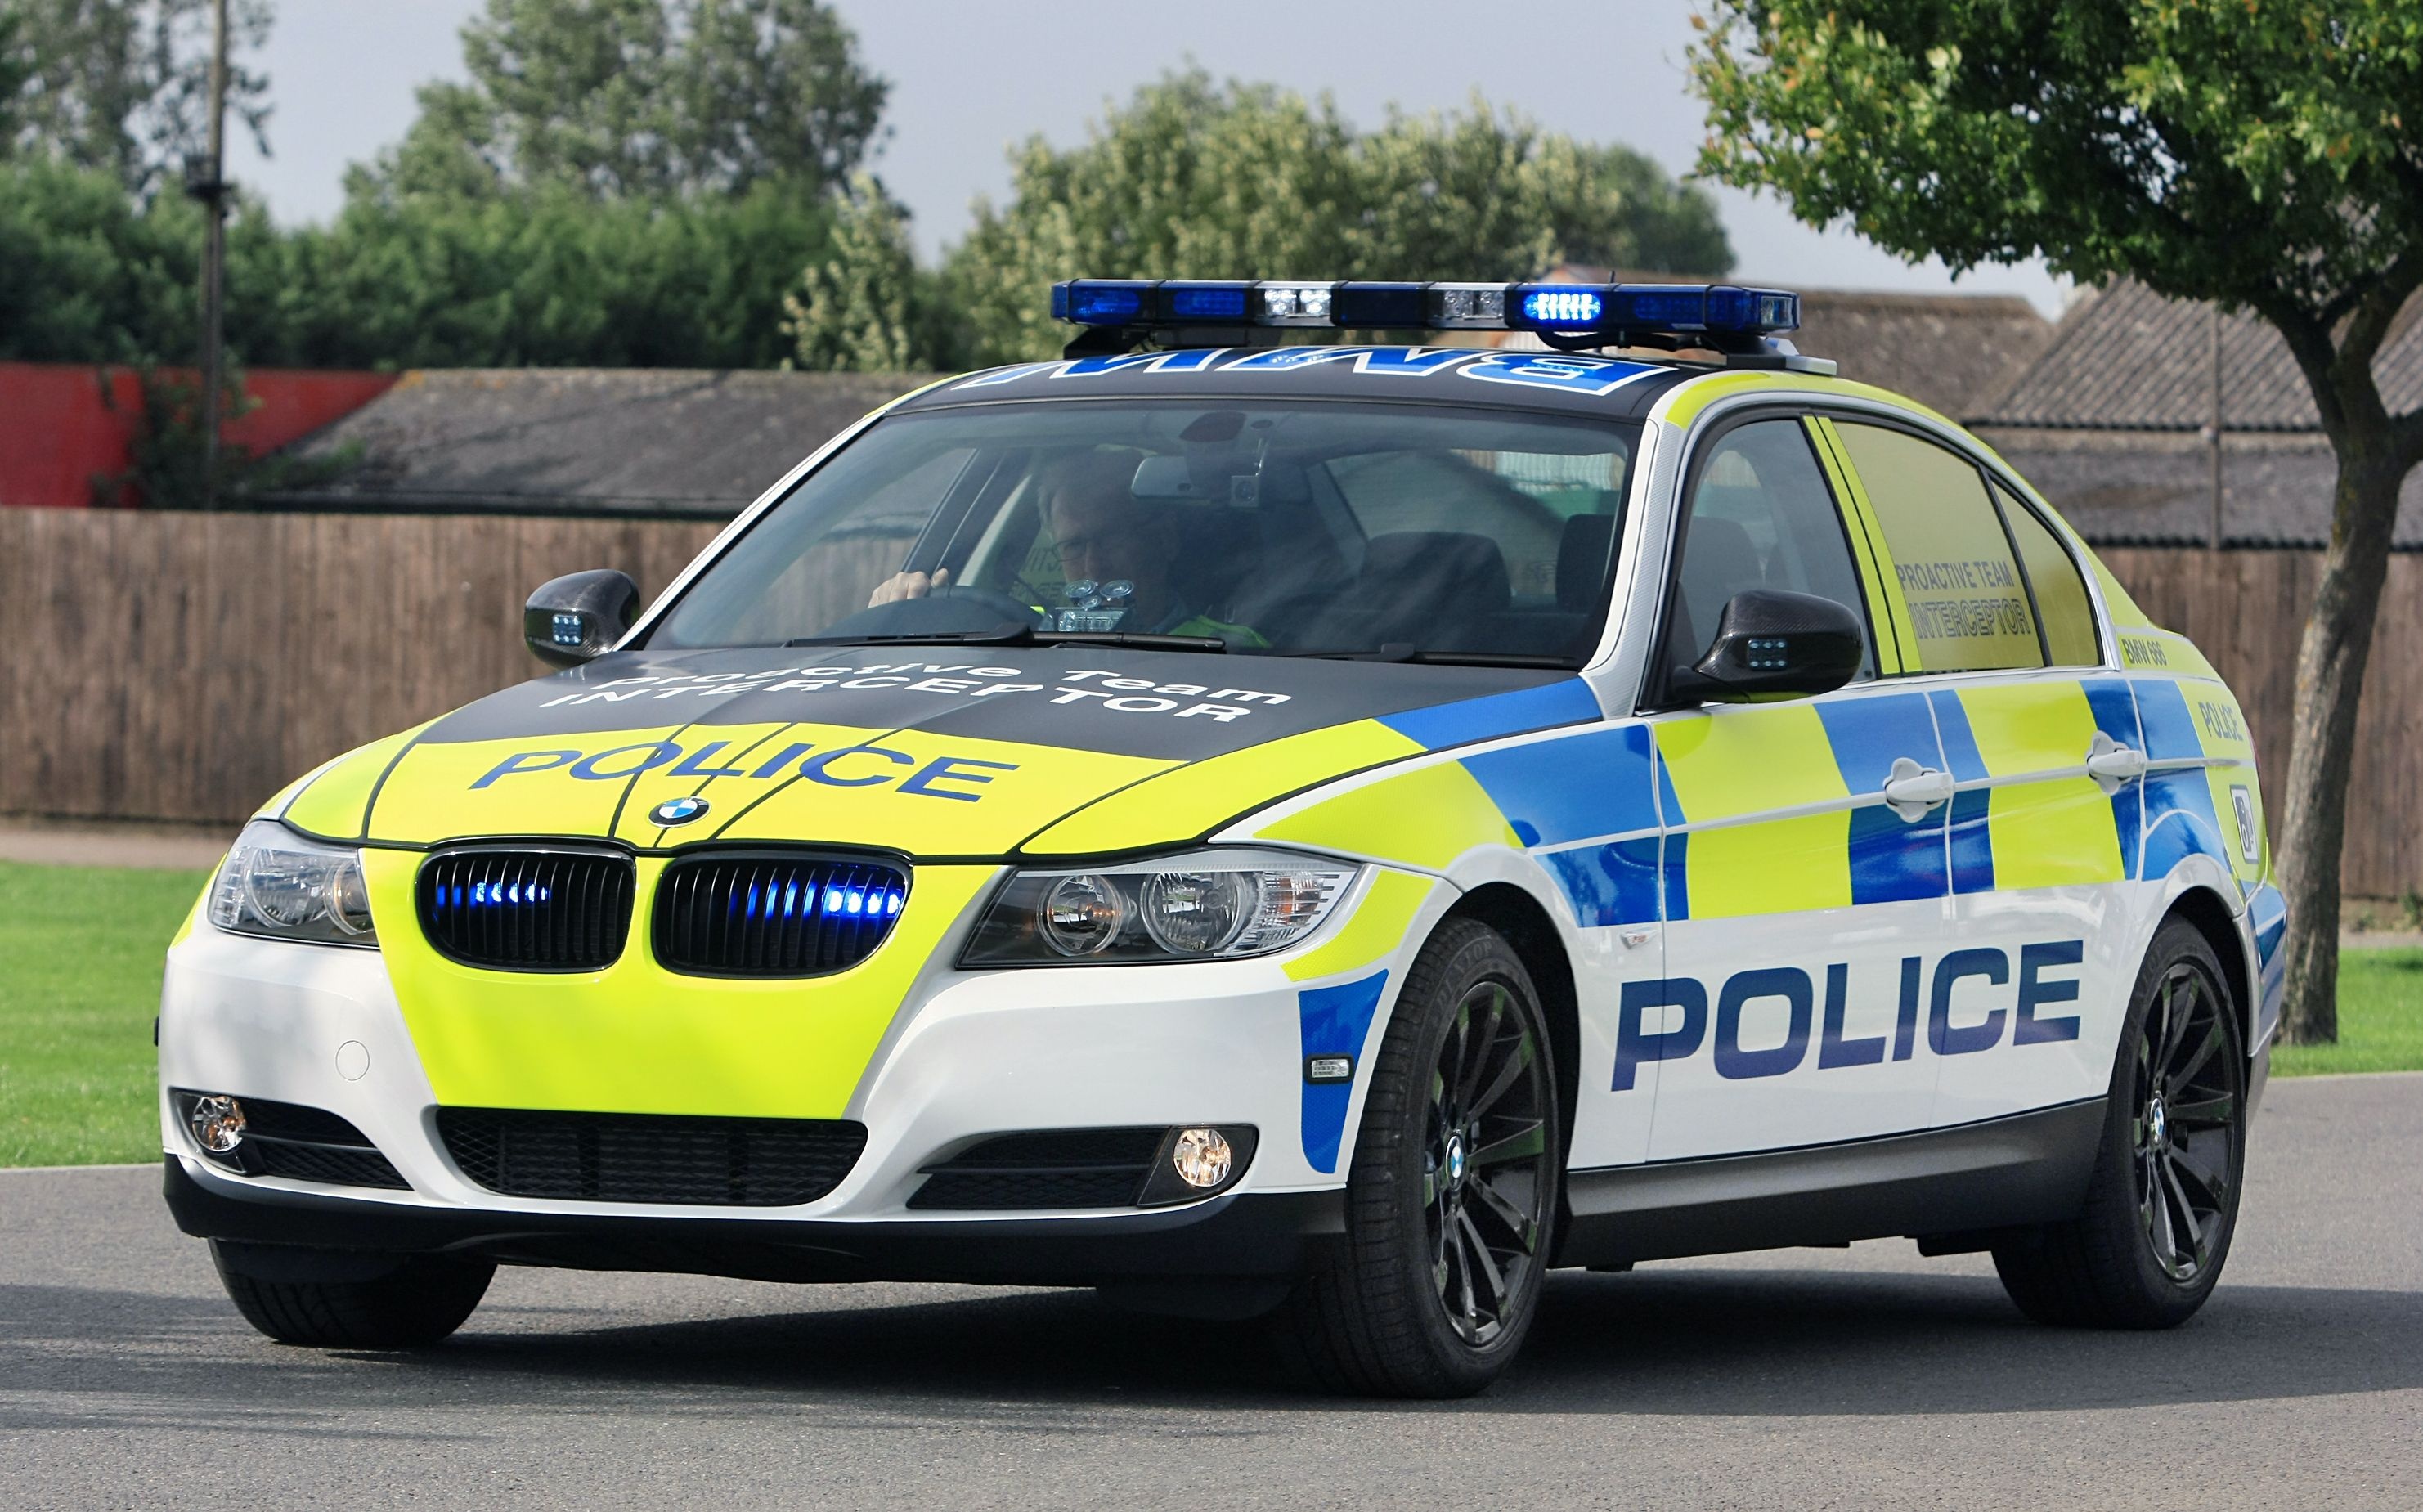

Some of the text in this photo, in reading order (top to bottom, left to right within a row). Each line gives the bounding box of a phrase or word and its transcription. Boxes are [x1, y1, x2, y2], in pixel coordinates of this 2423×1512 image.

[950, 347, 1679, 396] BMW
[1895, 561, 2015, 591] PROACTIVE TEAM
[1909, 598, 2031, 639] INTERCEPTOR
[2121, 639, 2151, 664] BMW
[539, 676, 1251, 723] INTERCEPTOR
[590, 662, 1293, 705] Proactive Team
[2198, 702, 2244, 742] POLICE
[468, 740, 1019, 803] POLICE
[1611, 940, 2084, 1092] POLICE
